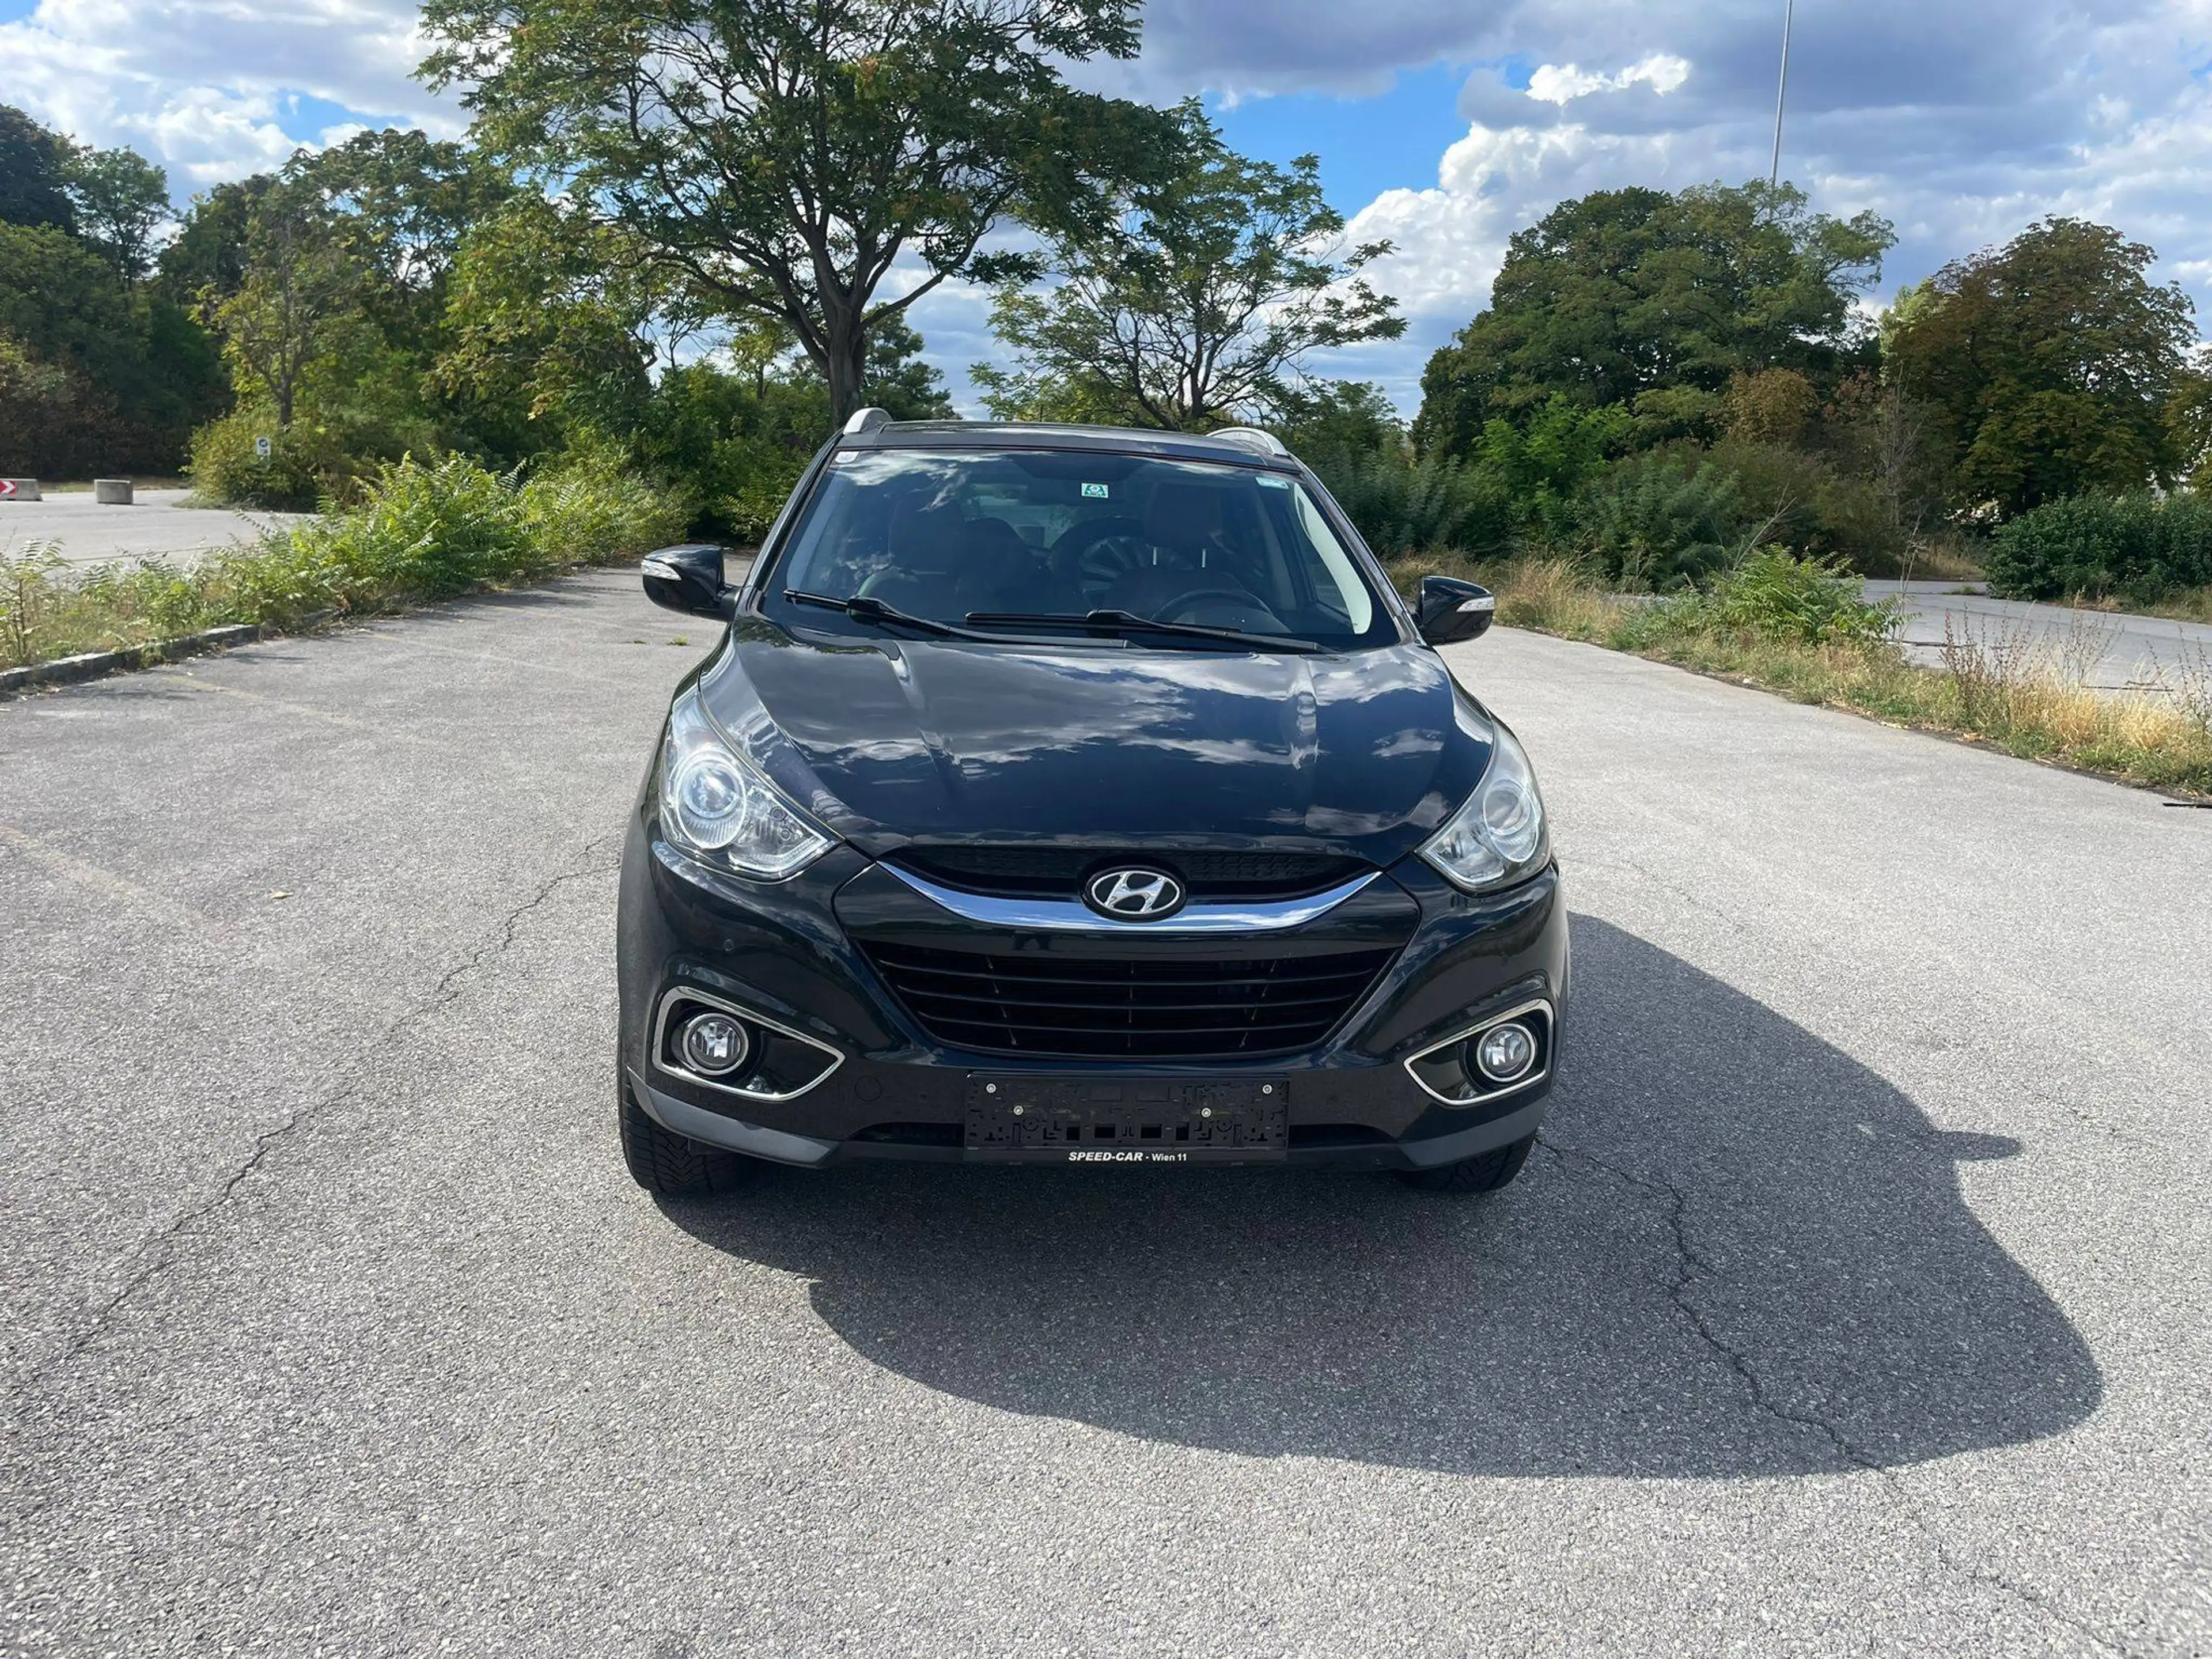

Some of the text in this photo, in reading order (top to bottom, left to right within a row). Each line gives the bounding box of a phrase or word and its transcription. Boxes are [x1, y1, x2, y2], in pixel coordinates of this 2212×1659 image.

[1068, 1152, 1143, 1161] SPEED-CAR
[1152, 1153, 1175, 1161] Wien
[1177, 1153, 1187, 1161] 11
